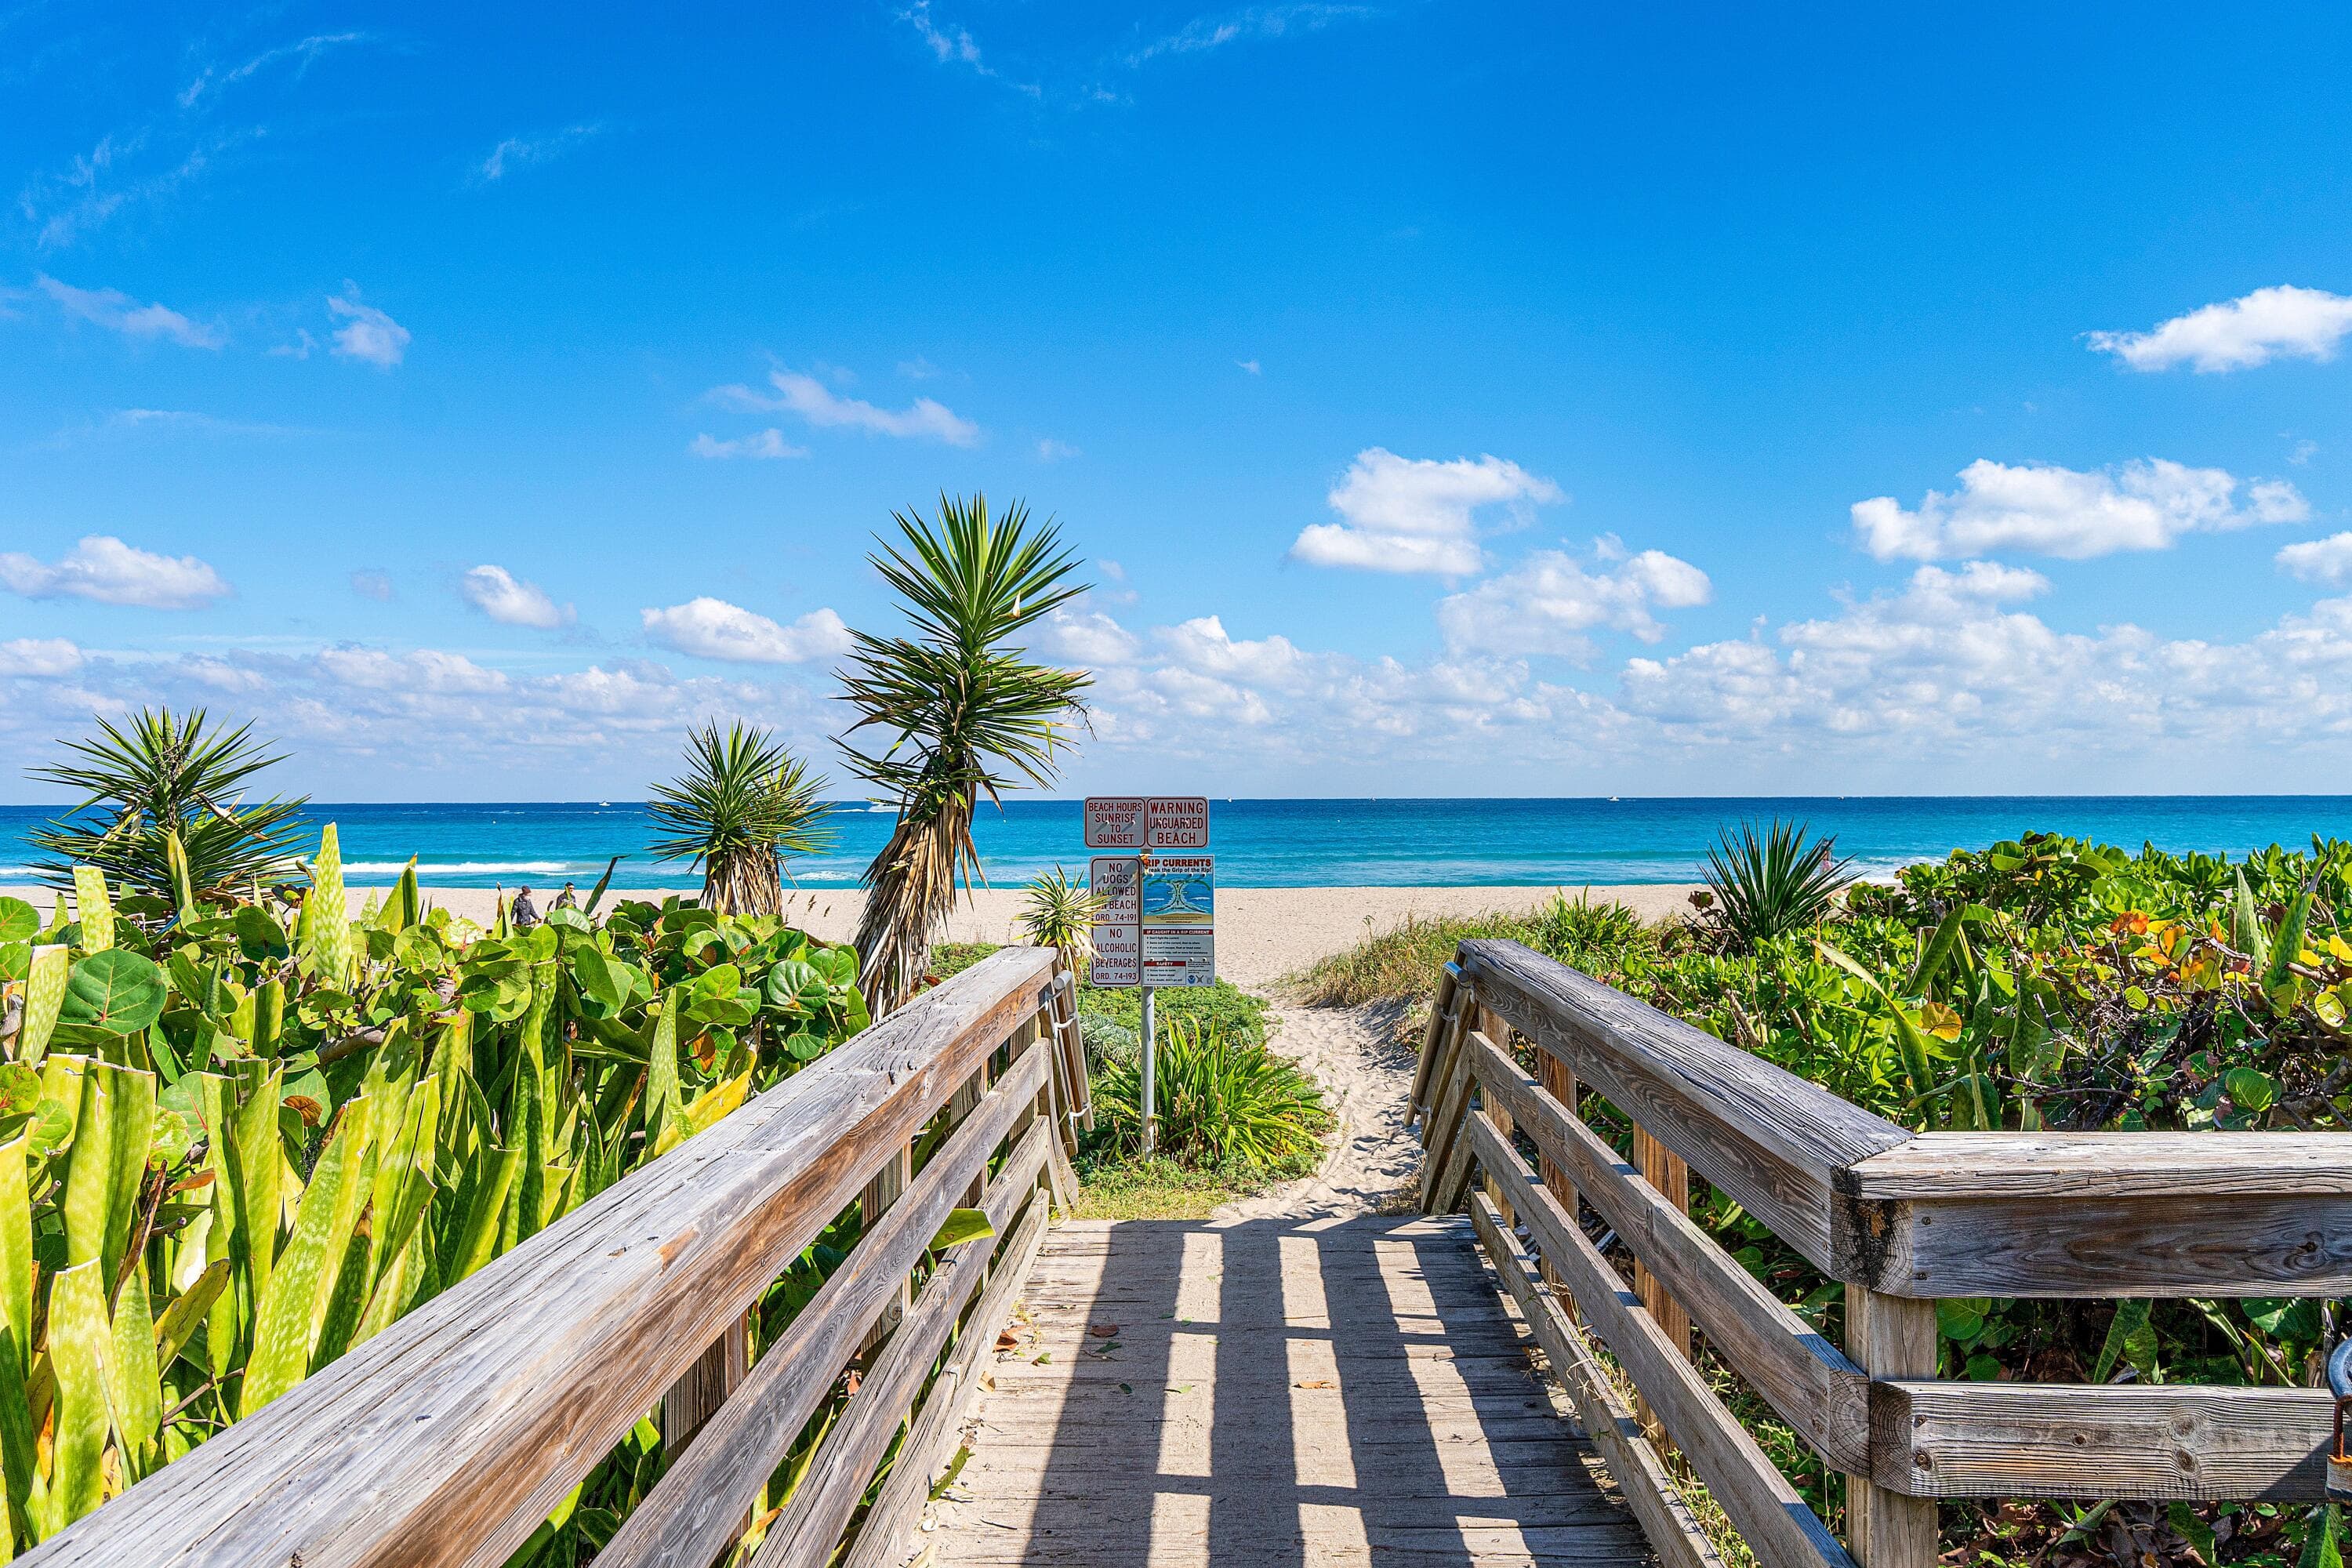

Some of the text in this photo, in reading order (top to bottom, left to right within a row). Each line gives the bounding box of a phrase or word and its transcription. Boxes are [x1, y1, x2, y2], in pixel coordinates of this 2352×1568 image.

[1088, 802, 1142, 811] BEACH HOURS
[1150, 802, 1203, 814] WARNING
[1094, 813, 1136, 822] SUNRISE
[1149, 817, 1203, 829] UNGUARDED
[1110, 824, 1121, 833] TO
[1098, 834, 1134, 844] SUNSET
[1157, 832, 1196, 844] BEACH
[1109, 862, 1123, 873] NO
[1163, 858, 1211, 867] CURRENTS
[1103, 874, 1129, 884] DOGS
[1097, 887, 1136, 896] ALLOWED
[1109, 900, 1137, 909] BEACH
[1109, 928, 1123, 938] NO
[1096, 943, 1137, 953] ALCOHOLIC
[1095, 958, 1137, 968] BEVERAGES
